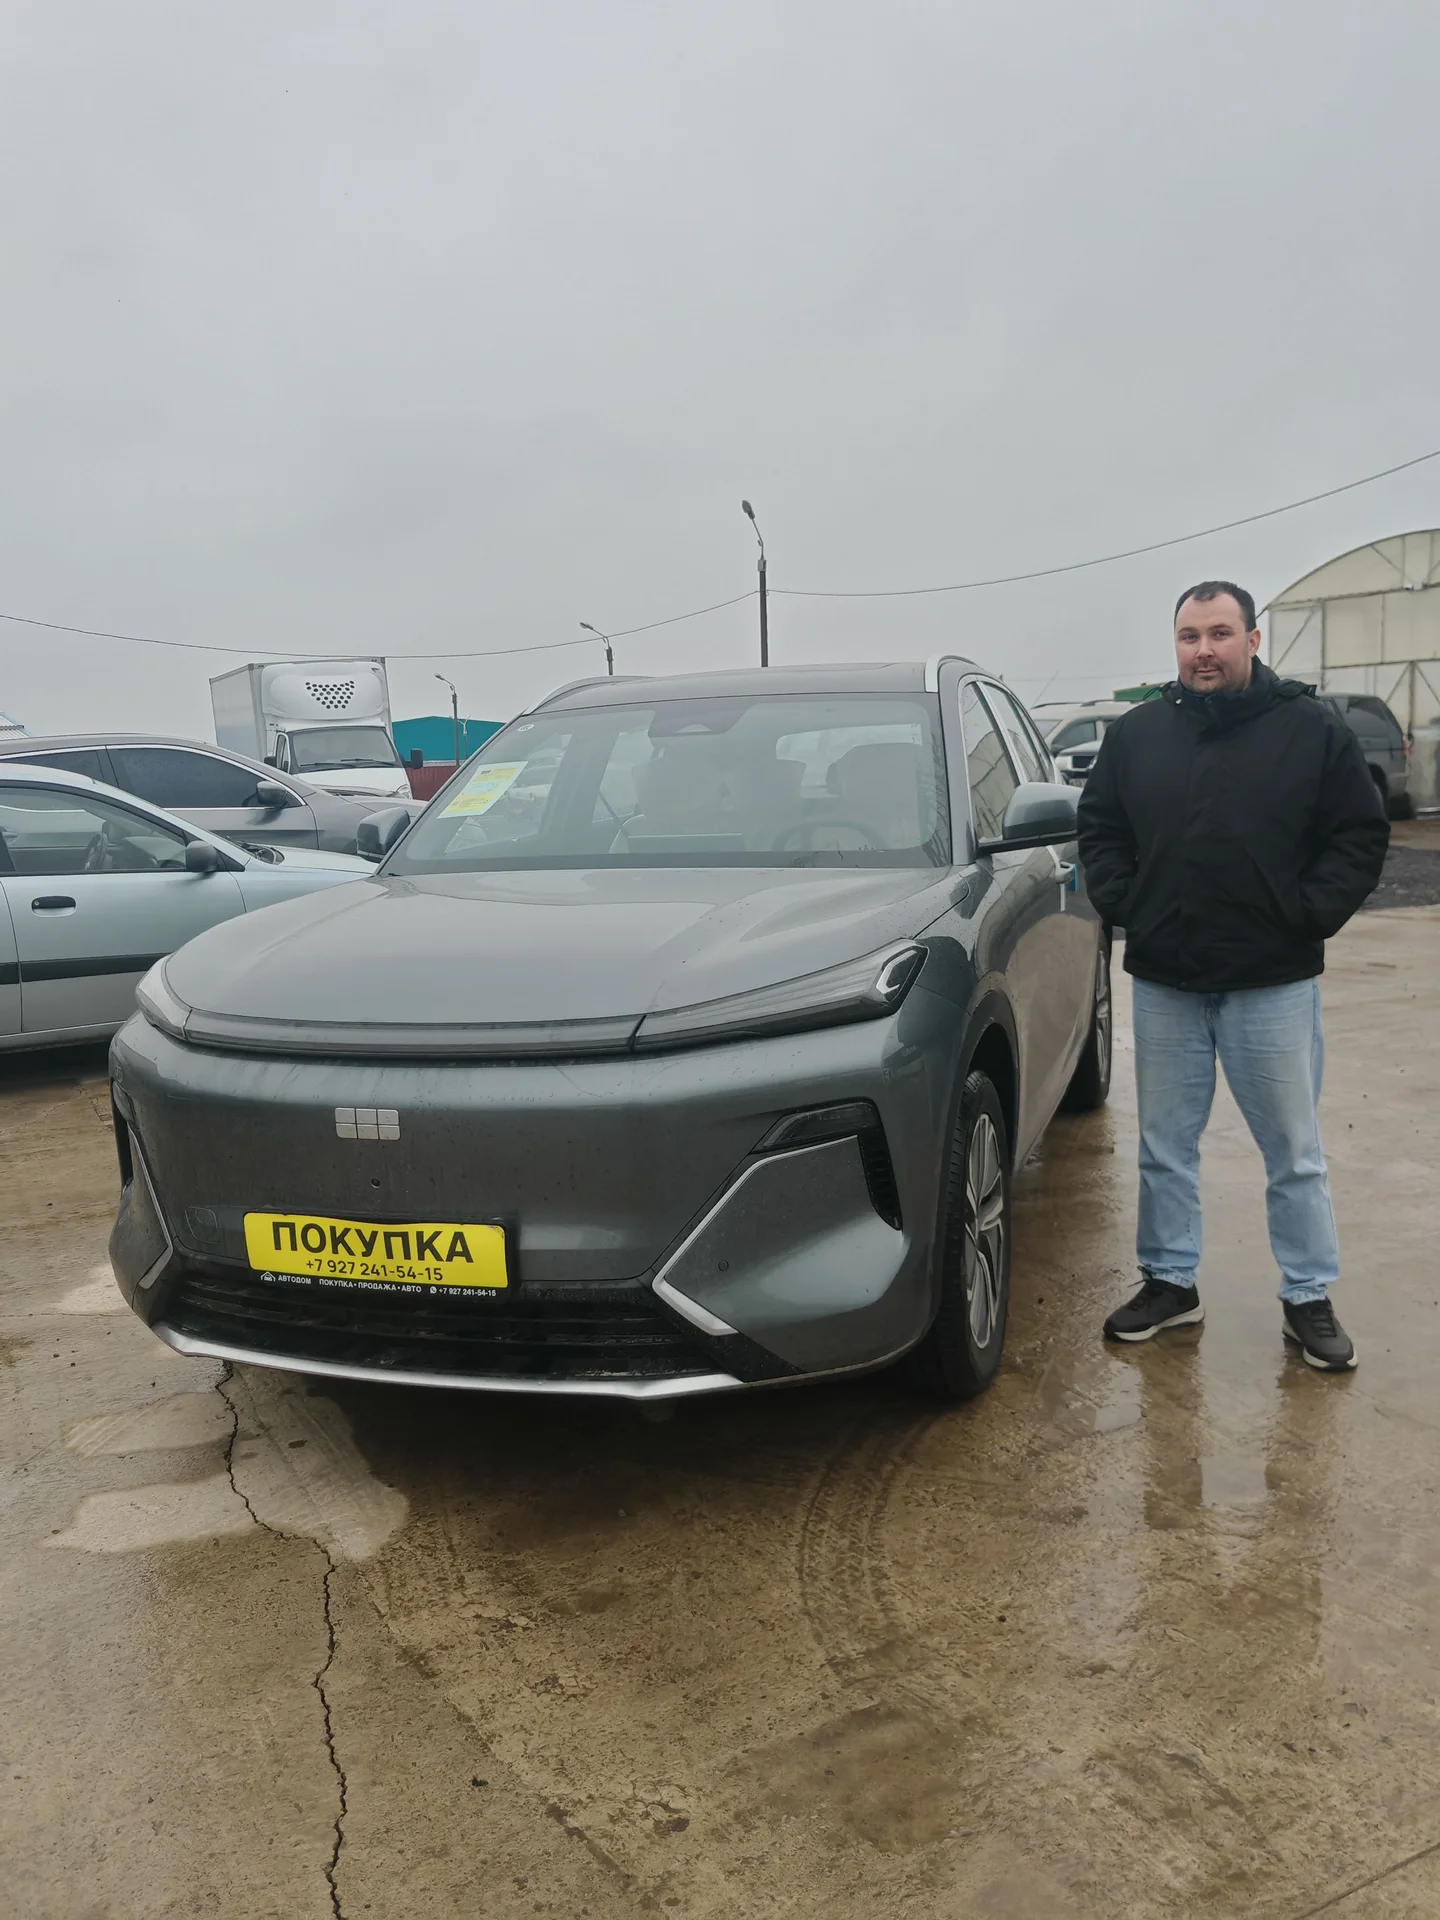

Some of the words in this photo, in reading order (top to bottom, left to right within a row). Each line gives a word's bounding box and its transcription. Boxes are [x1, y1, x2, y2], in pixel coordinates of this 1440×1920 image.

[272, 1221, 475, 1264] ПОКУПКА
[306, 1258, 322, 1272] +7
[327, 1259, 355, 1275] 927
[360, 1263, 444, 1281] 241-54-15
[278, 1275, 311, 1285] АВТОДОМ
[449, 1287, 461, 1296] 927
[463, 1288, 497, 1297] 241-54-15
